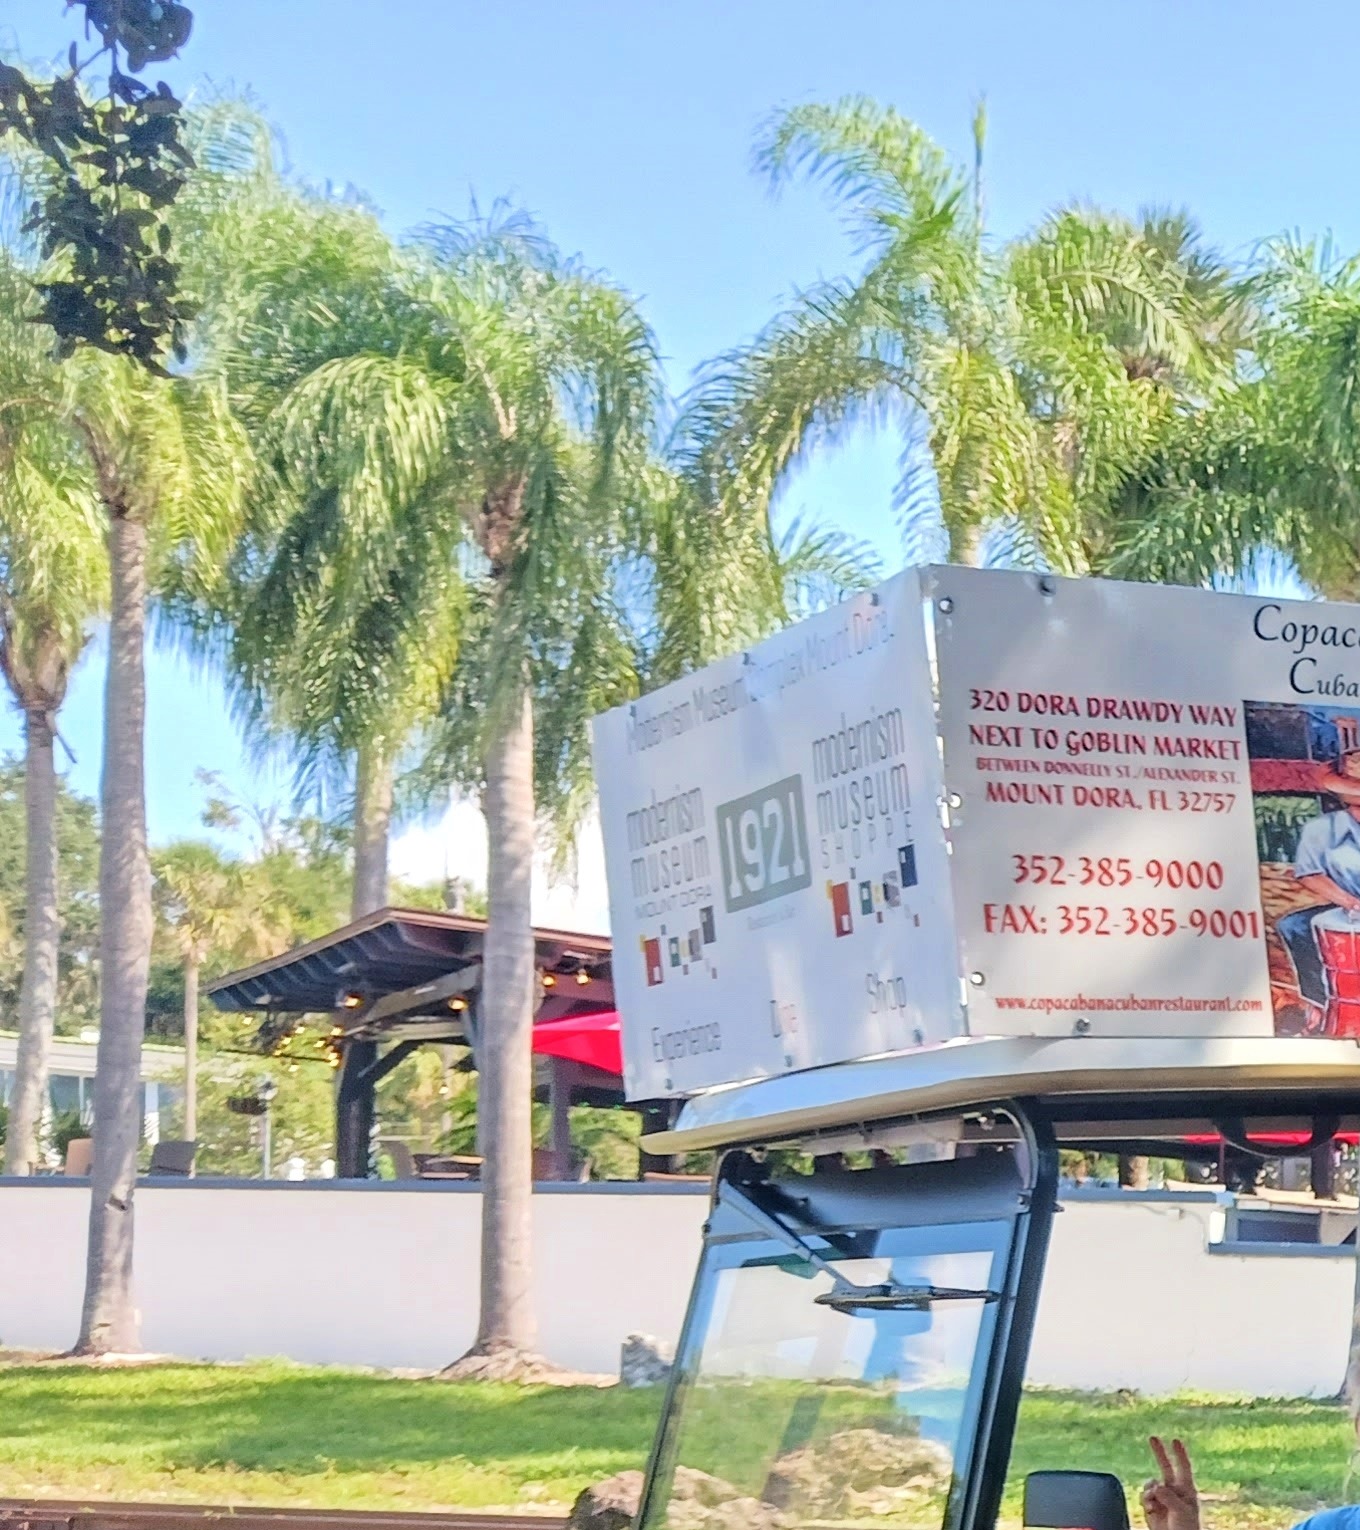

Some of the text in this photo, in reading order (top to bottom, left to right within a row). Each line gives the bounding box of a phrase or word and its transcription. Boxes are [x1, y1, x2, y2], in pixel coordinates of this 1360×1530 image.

[969, 689, 1237, 727] 320 DORA DRAWDY WAY
[812, 705, 906, 784] modernism
[969, 724, 1242, 761] NEXT TO GOBLIN MARKET
[976, 757, 1040, 773] BETWEEN
[1044, 761, 1112, 778] DONNELLY
[626, 785, 706, 851] modernism
[816, 763, 911, 836] museum
[986, 781, 1065, 806] MOUNT
[1149, 790, 1172, 811] FL
[1178, 791, 1236, 814] 32757
[724, 791, 806, 898] 1921
[820, 811, 912, 869] SHOPPE
[631, 836, 711, 898] museum
[1012, 855, 1224, 890] 352-385-9000
[983, 903, 1260, 939] FAX: 352-385-9001
[866, 973, 907, 1018] Shop
[995, 994, 1263, 1015] www.copacabanacubanrestaurant.com
